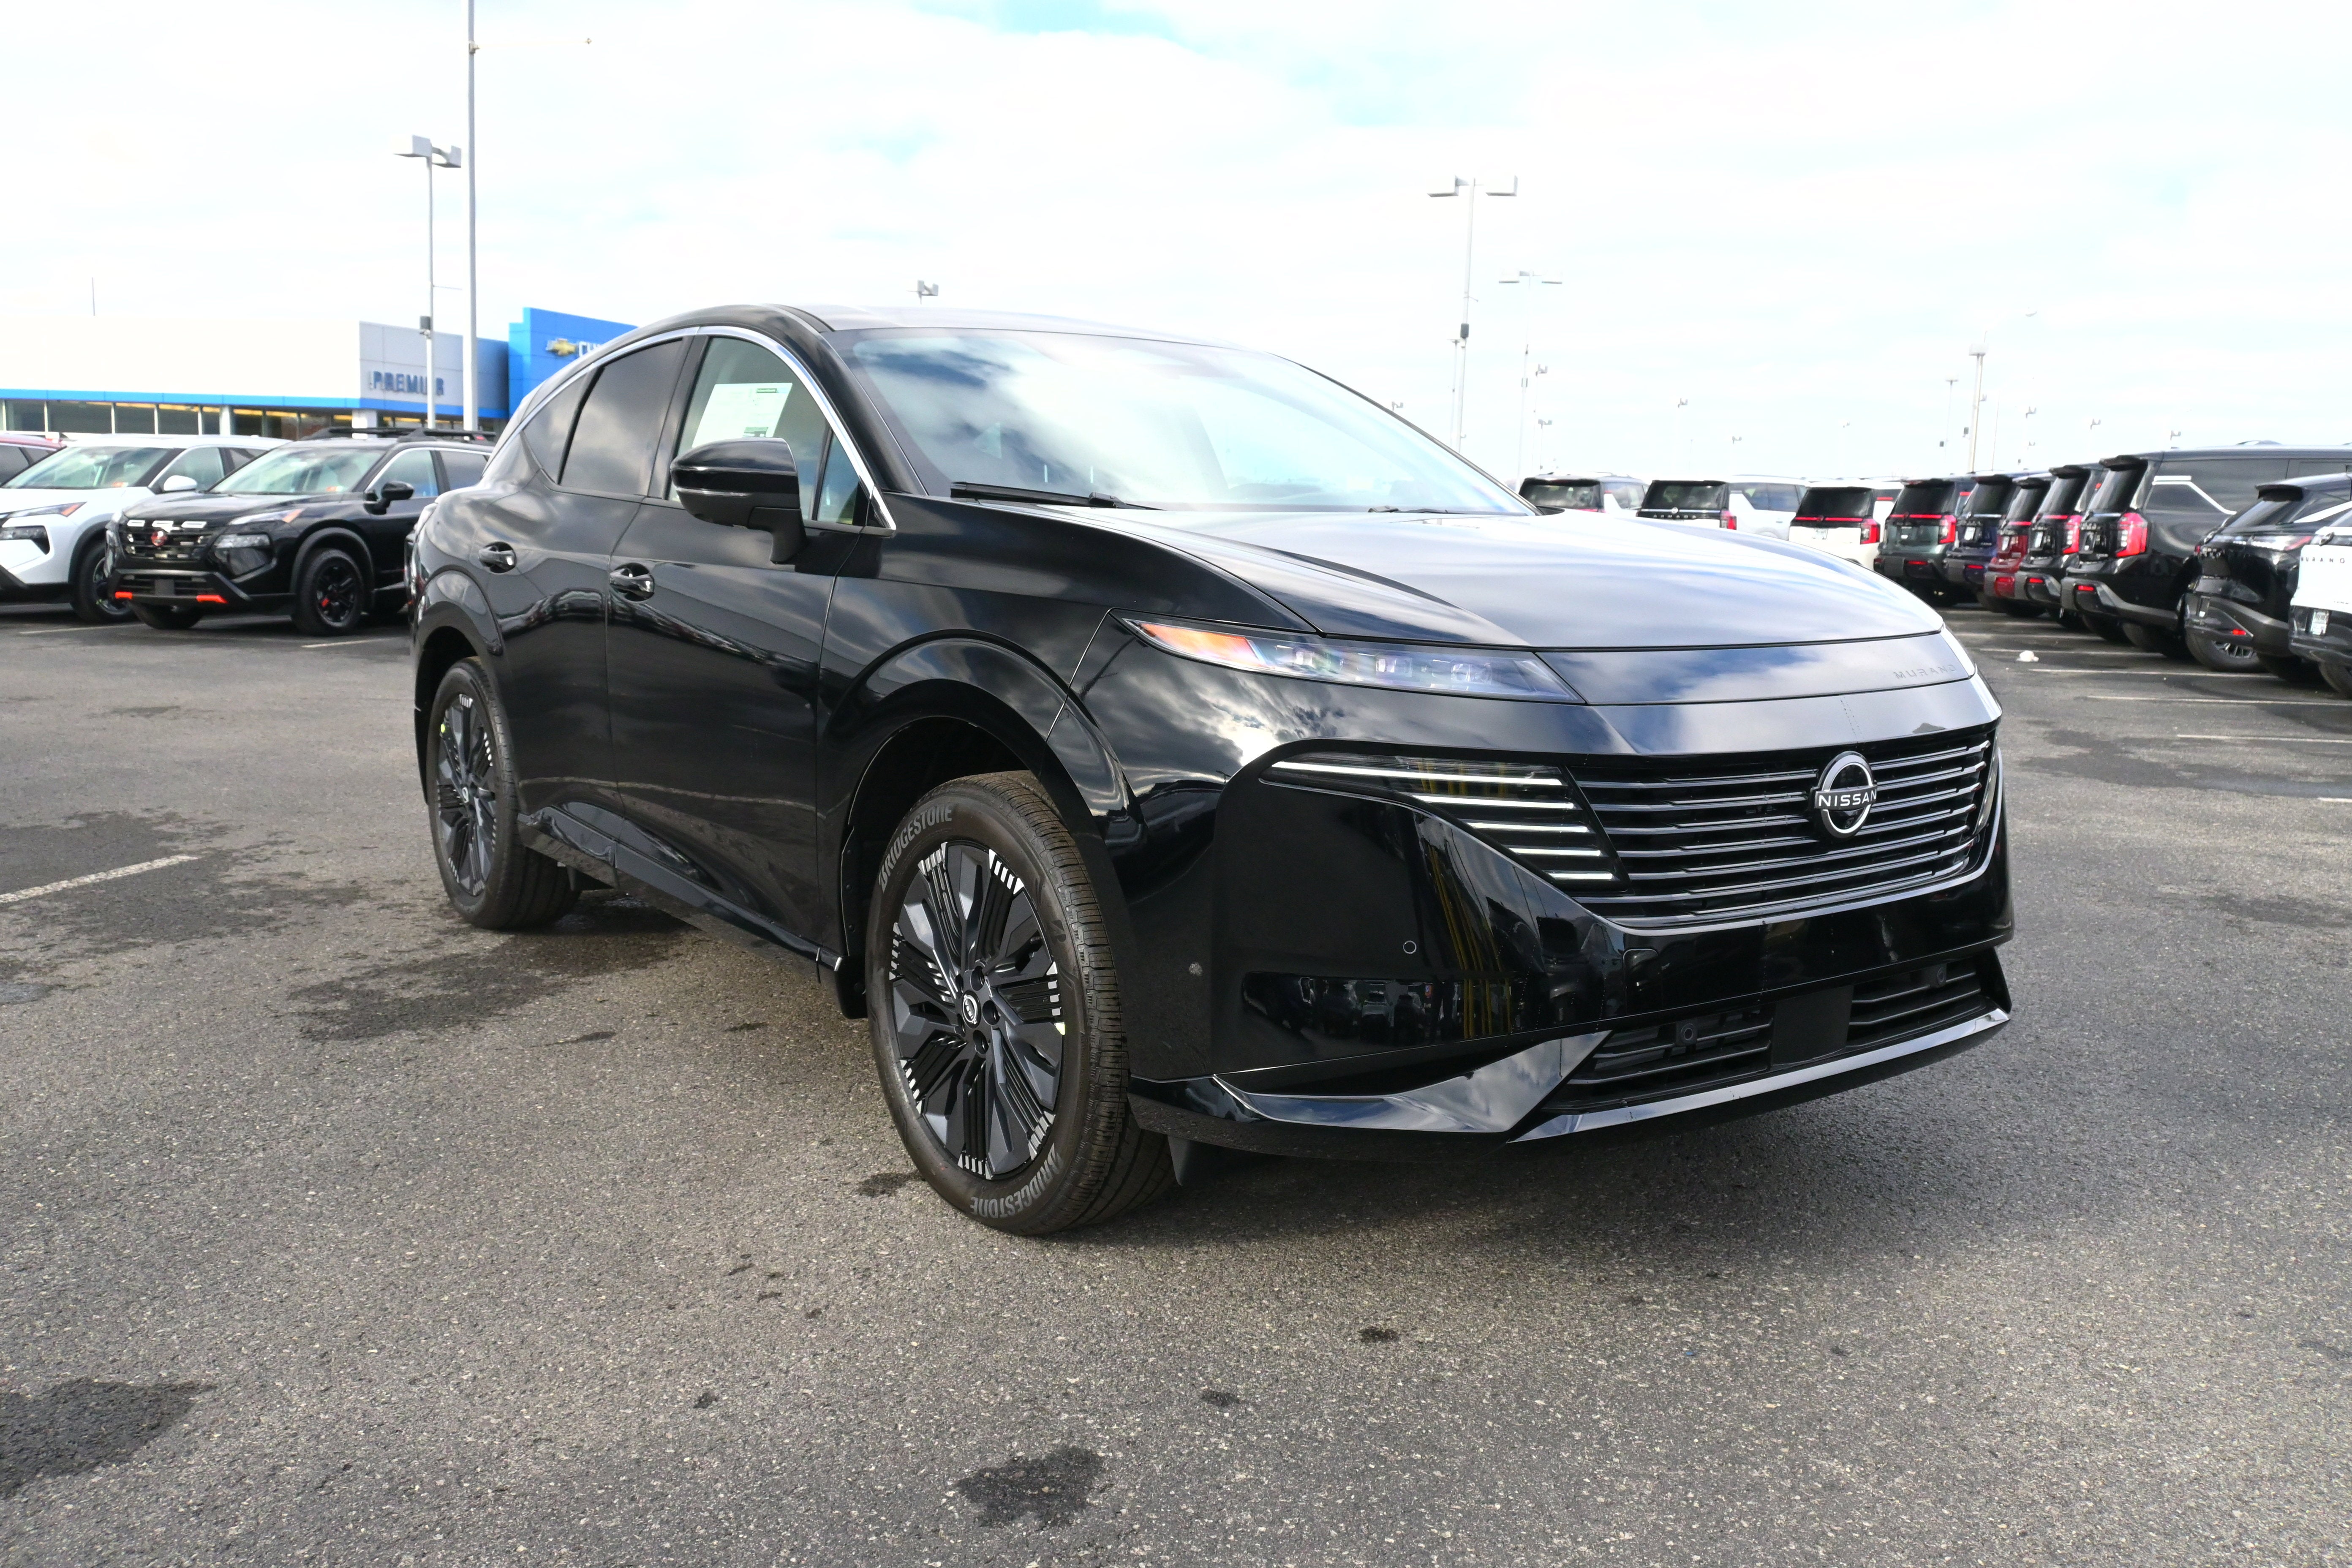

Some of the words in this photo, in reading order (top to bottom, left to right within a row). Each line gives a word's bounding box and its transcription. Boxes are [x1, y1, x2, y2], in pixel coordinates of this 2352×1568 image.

[373, 370, 444, 396] PREMIR
[1893, 664, 1956, 679] MURANO
[1818, 788, 1877, 807] NISSAN
[879, 804, 953, 893] BRIDGESTONE
